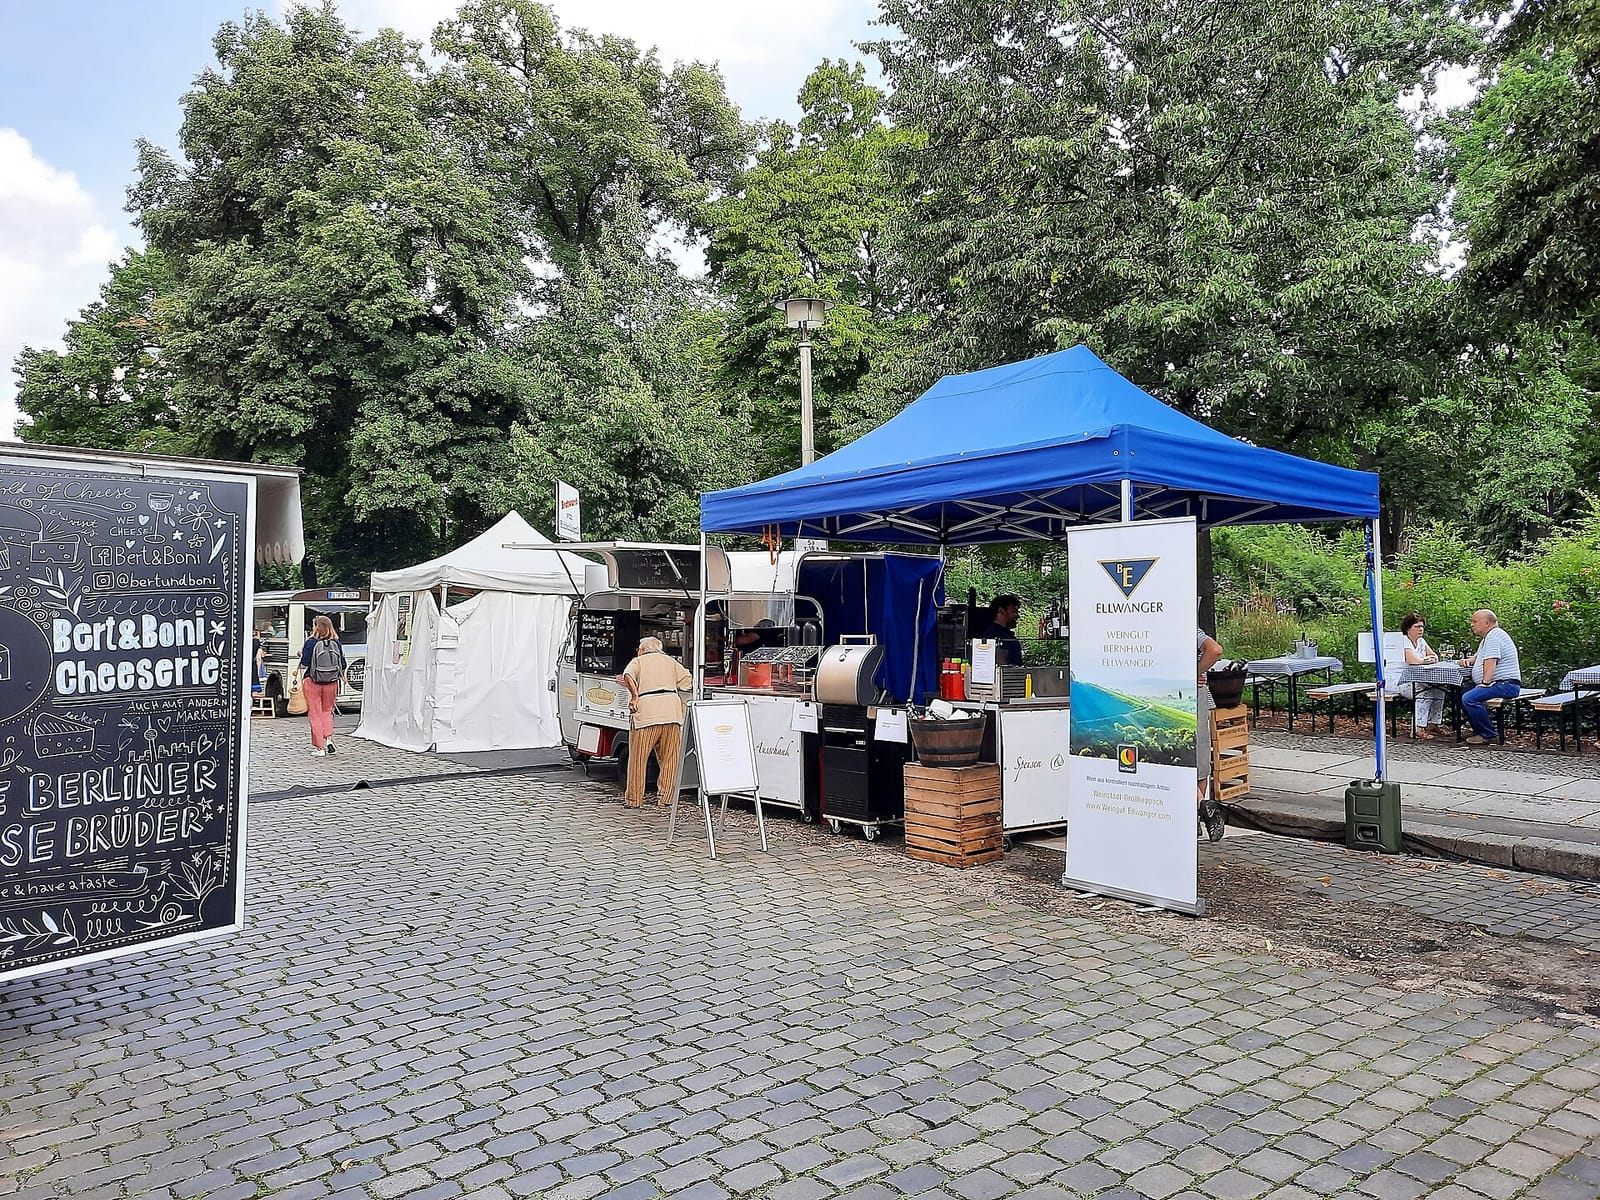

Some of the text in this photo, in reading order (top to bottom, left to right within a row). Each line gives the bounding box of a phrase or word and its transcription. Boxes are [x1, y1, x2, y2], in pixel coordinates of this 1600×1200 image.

[36, 482, 61, 500] of
[63, 481, 141, 499] Cheese
[116, 515, 135, 525] WE
[109, 525, 153, 537] CHEESE!
[115, 545, 201, 566] Bert&Boni
[116, 572, 216, 589] @bertundboni
[1096, 602, 1164, 614] ELLWANGER
[52, 610, 206, 653] Bert&Boni
[1106, 630, 1150, 640] WEINGUT
[1103, 644, 1153, 654] BERNHARD
[1101, 658, 1154, 668] ELLWANGER
[55, 650, 220, 696] Cheeserie
[127, 698, 228, 711] AUCH AUF ANDERN
[65, 806, 204, 858] BRÜDER
[14, 884, 25, 896] &
[28, 881, 66, 895] have
